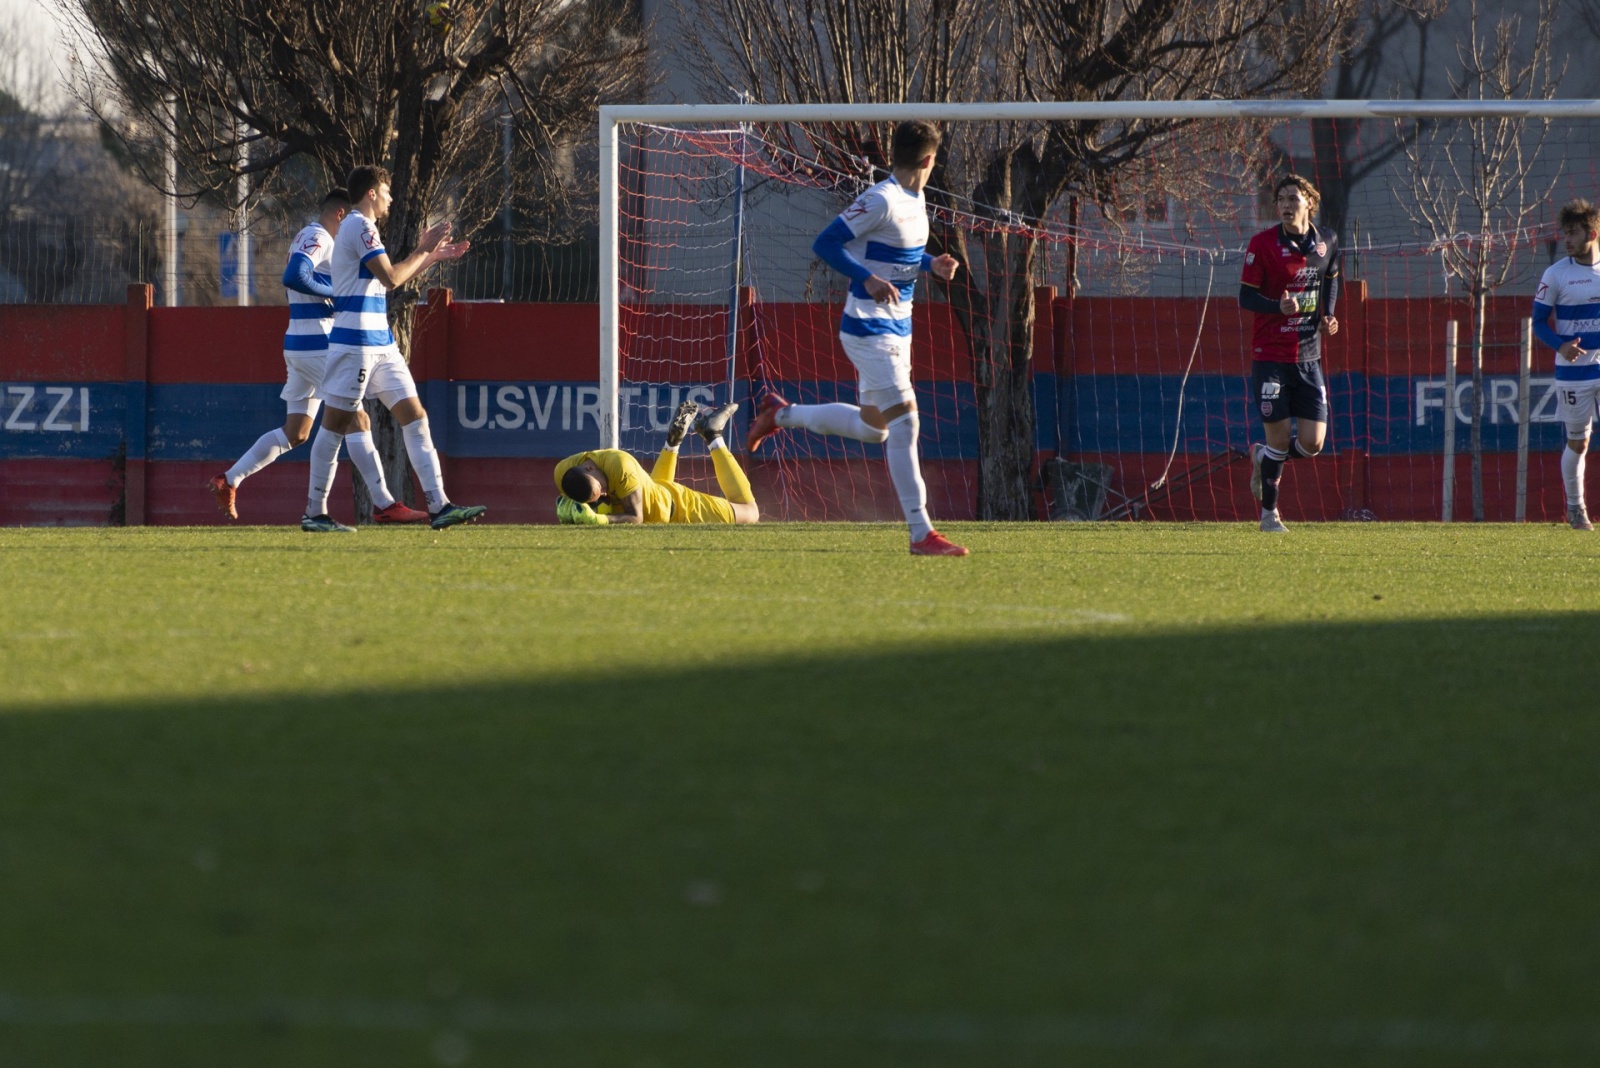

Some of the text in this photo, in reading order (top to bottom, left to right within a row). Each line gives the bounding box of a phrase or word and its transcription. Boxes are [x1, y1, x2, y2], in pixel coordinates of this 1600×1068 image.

[357, 368, 367, 383] 5
[0, 386, 89, 432] ZZI
[1416, 378, 1598, 426] FORZ
[1562, 390, 1577, 405] 15
